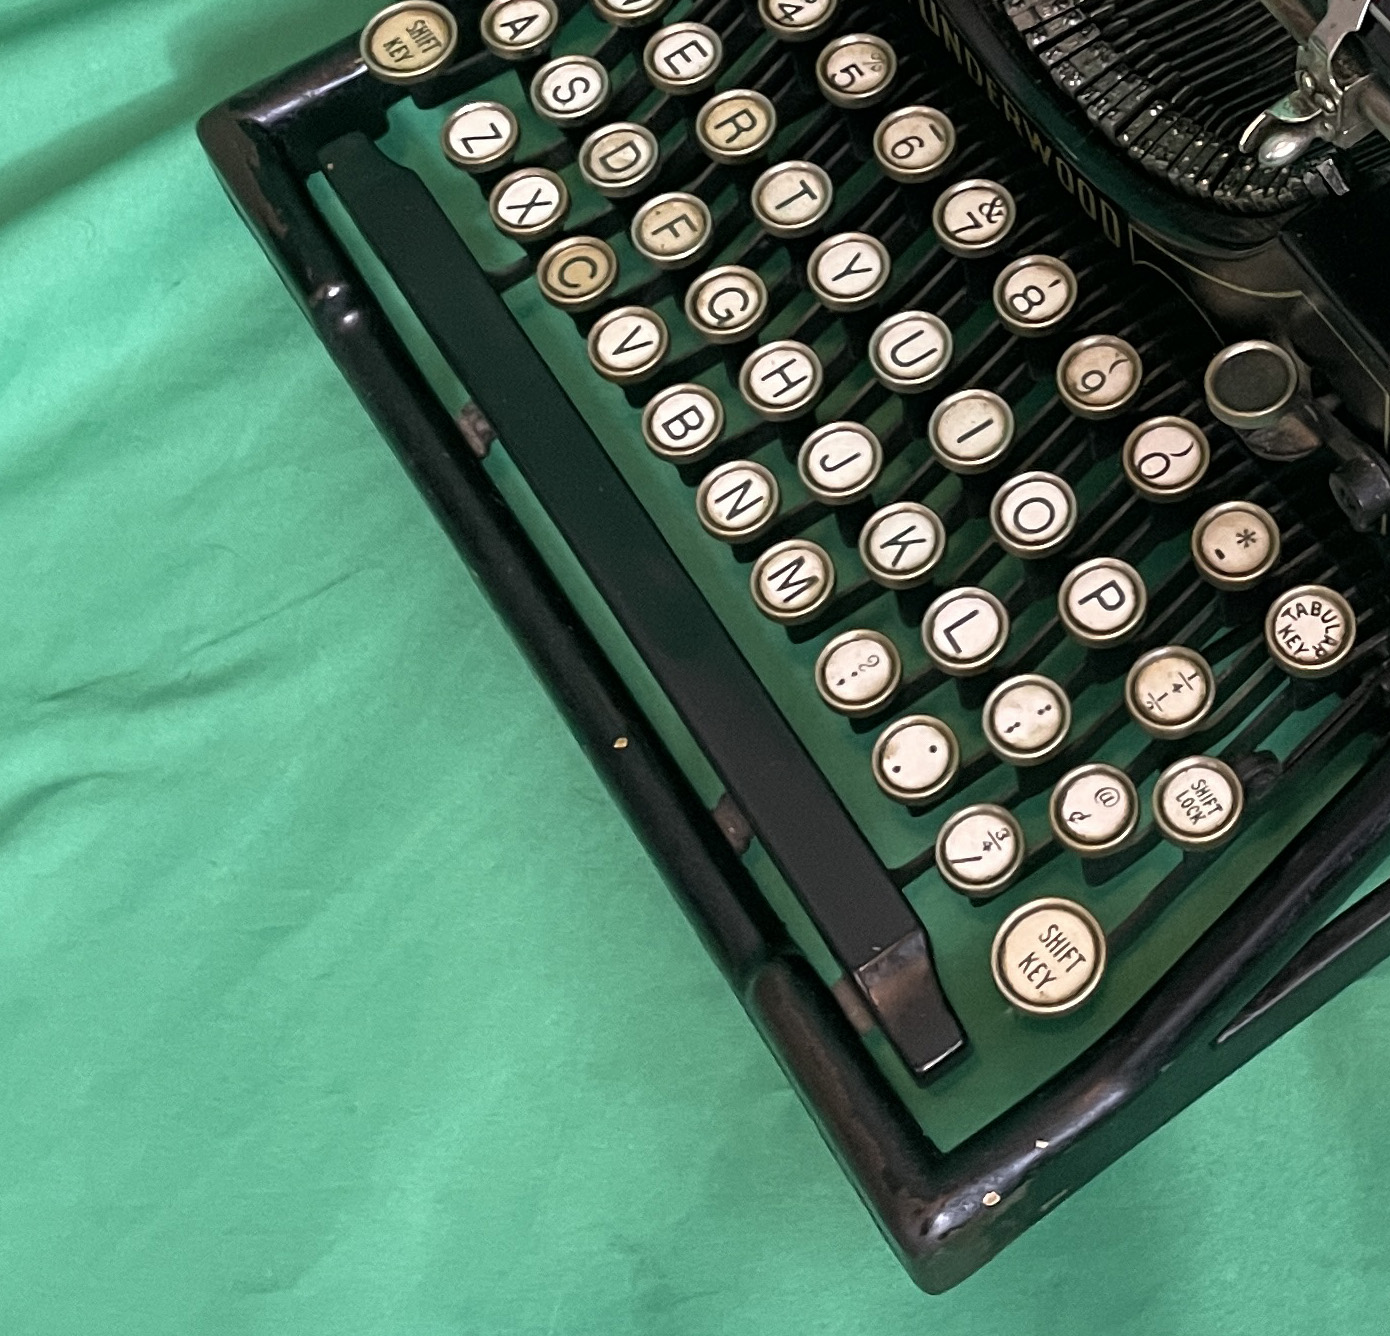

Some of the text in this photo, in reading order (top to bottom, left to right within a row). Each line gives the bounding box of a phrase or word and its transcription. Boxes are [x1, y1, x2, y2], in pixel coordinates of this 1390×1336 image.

[500, 14, 539, 41] A
[776, 3, 804, 22] 4
[383, 37, 414, 63] KEY
[405, 19, 442, 53] SHIFT
[663, 40, 708, 75] E
[553, 76, 591, 104] S
[831, 63, 864, 88] 5
[461, 122, 503, 154] Z
[714, 108, 757, 144] R
[600, 140, 642, 172] D
[891, 135, 924, 159] 6
[506, 188, 552, 224] X
[775, 179, 818, 210] T
[979, 196, 1004, 223] &
[651, 213, 697, 239] F
[952, 211, 983, 237] 7
[558, 255, 598, 288] C
[832, 252, 873, 281] Y
[708, 287, 750, 326] G
[1009, 285, 1045, 315] 8
[612, 325, 653, 356] V
[891, 330, 938, 368] U
[761, 358, 808, 398] H
[1075, 369, 1106, 394] 9
[661, 404, 705, 441] B
[957, 418, 994, 443] I
[820, 452, 861, 472] J
[714, 478, 764, 521] N
[1013, 496, 1056, 534] O
[880, 525, 927, 567] K
[767, 555, 819, 604] M
[1078, 579, 1125, 611] P
[943, 609, 979, 654] L
[1278, 624, 1309, 656] KEY
[1095, 786, 1121, 808] @
[1176, 789, 1206, 825] LOCK
[1191, 779, 1224, 816] SHIFT
[1038, 924, 1086, 973] SHIFT
[1018, 951, 1057, 990] KEY
